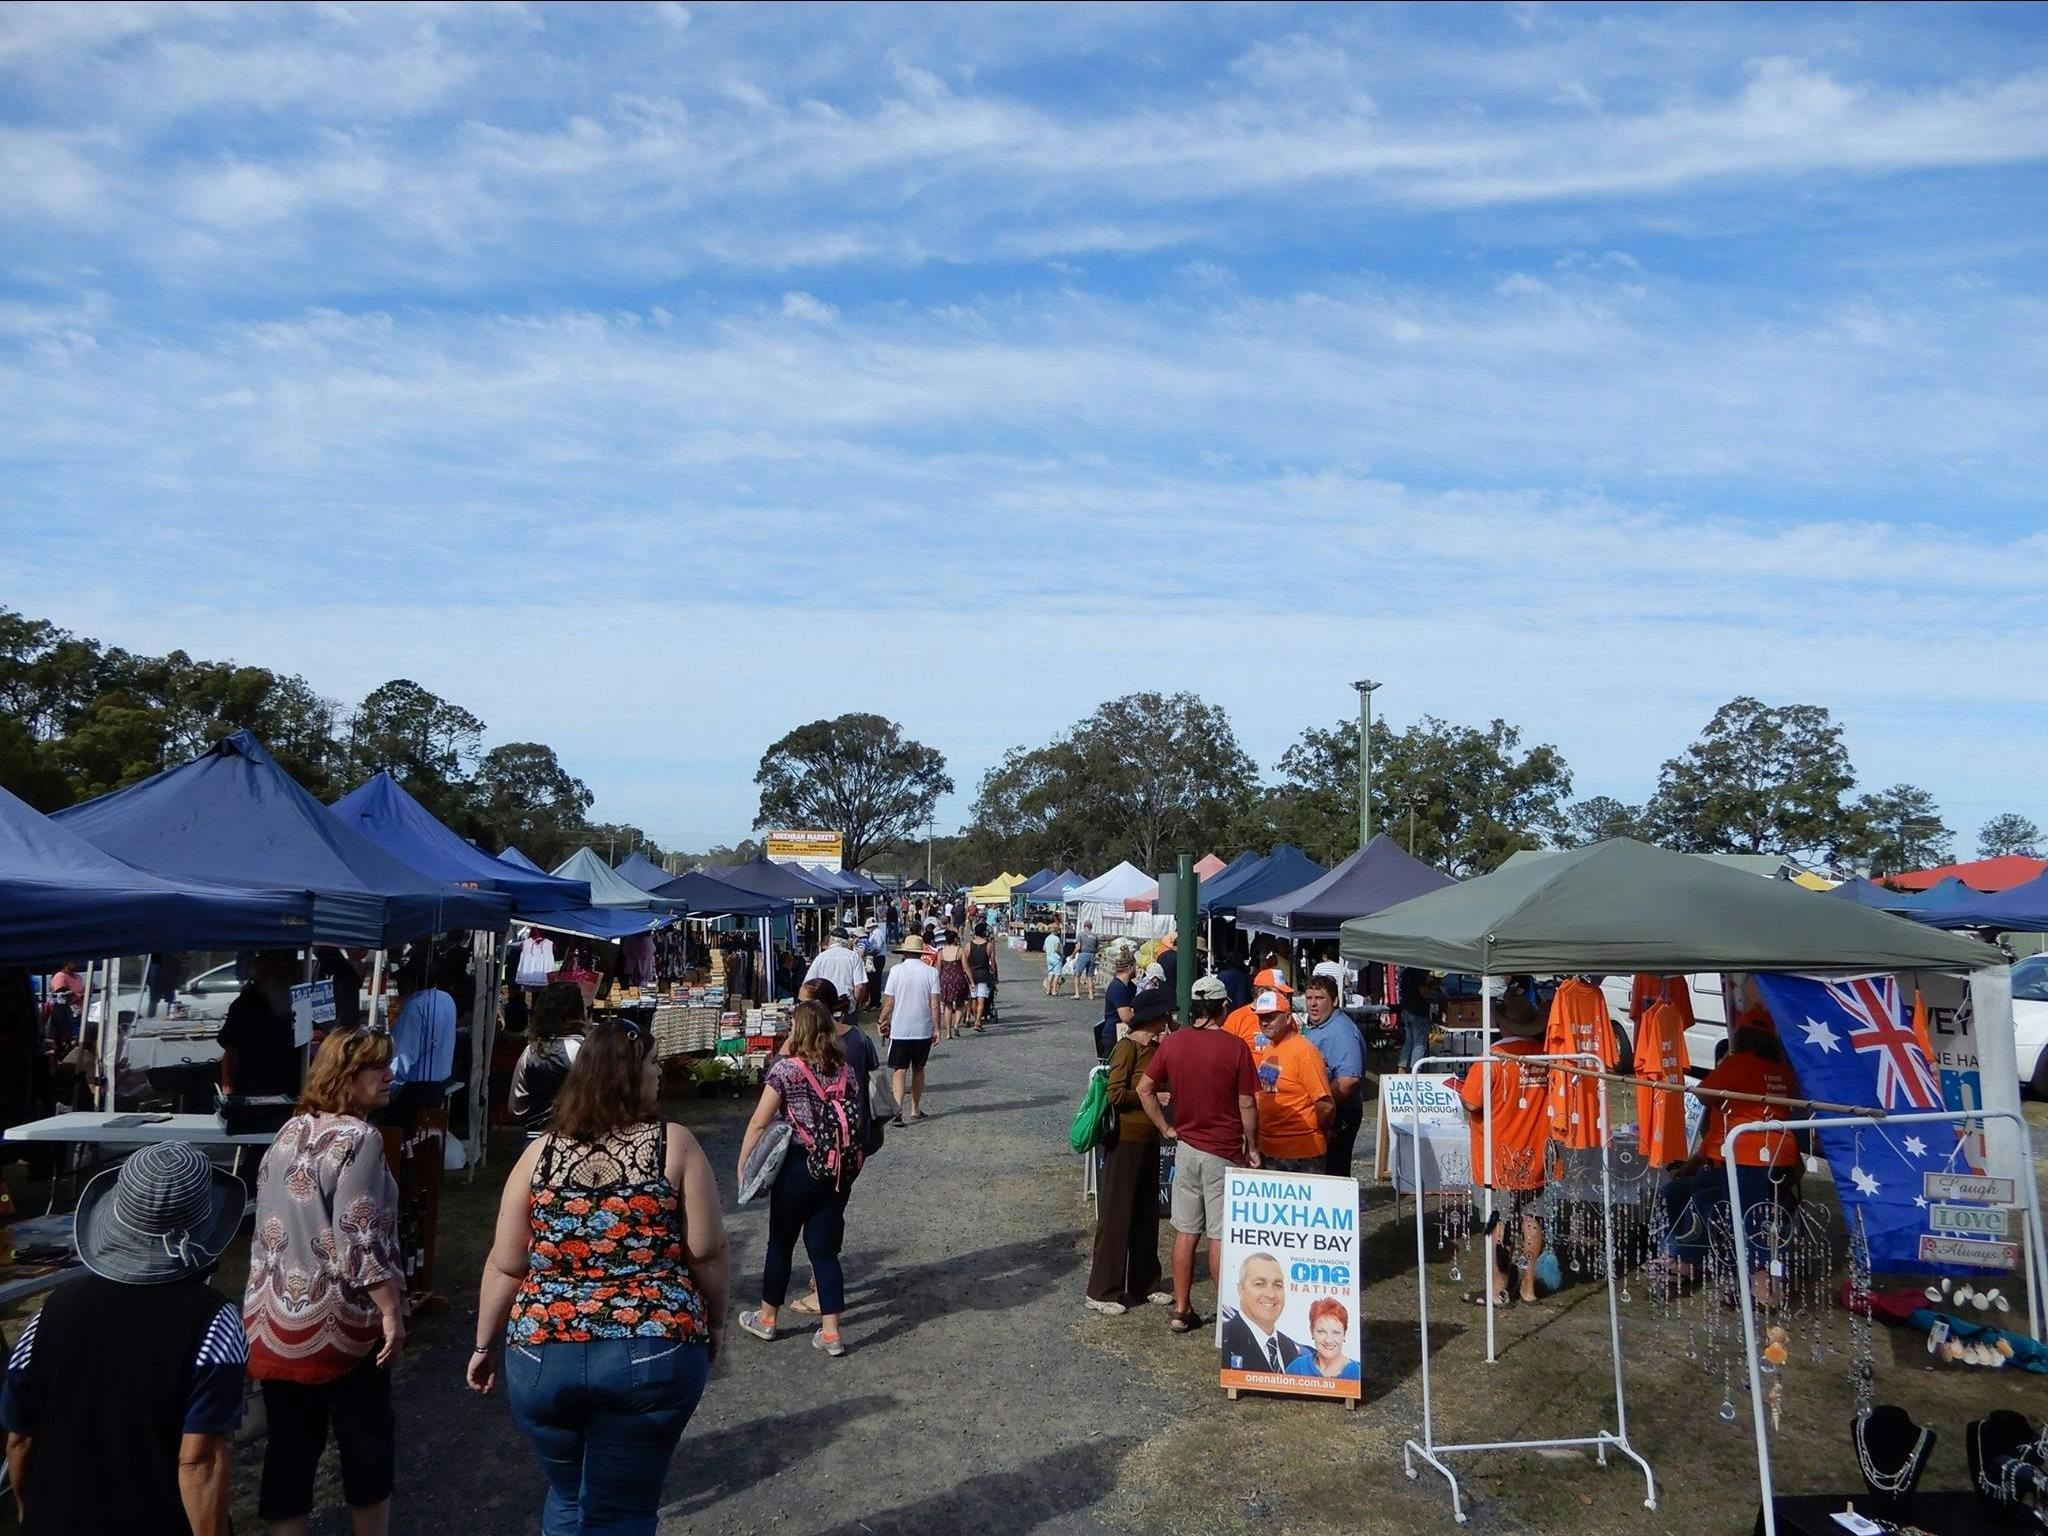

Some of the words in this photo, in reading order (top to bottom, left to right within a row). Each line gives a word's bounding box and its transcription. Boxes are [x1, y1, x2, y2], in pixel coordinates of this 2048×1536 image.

[1935, 1052, 1951, 1066] NE
[1957, 1054, 1979, 1067] HA
[1231, 1180, 1312, 1201] DAMIAN
[1231, 1200, 1353, 1231] HUXHAM
[1230, 1227, 1309, 1249] HERVEY
[1313, 1234, 1353, 1252] BAY
[1291, 1263, 1350, 1286] one
[1290, 1284, 1350, 1296] NATION
[1245, 1374, 1335, 1390] onenation.com.au
